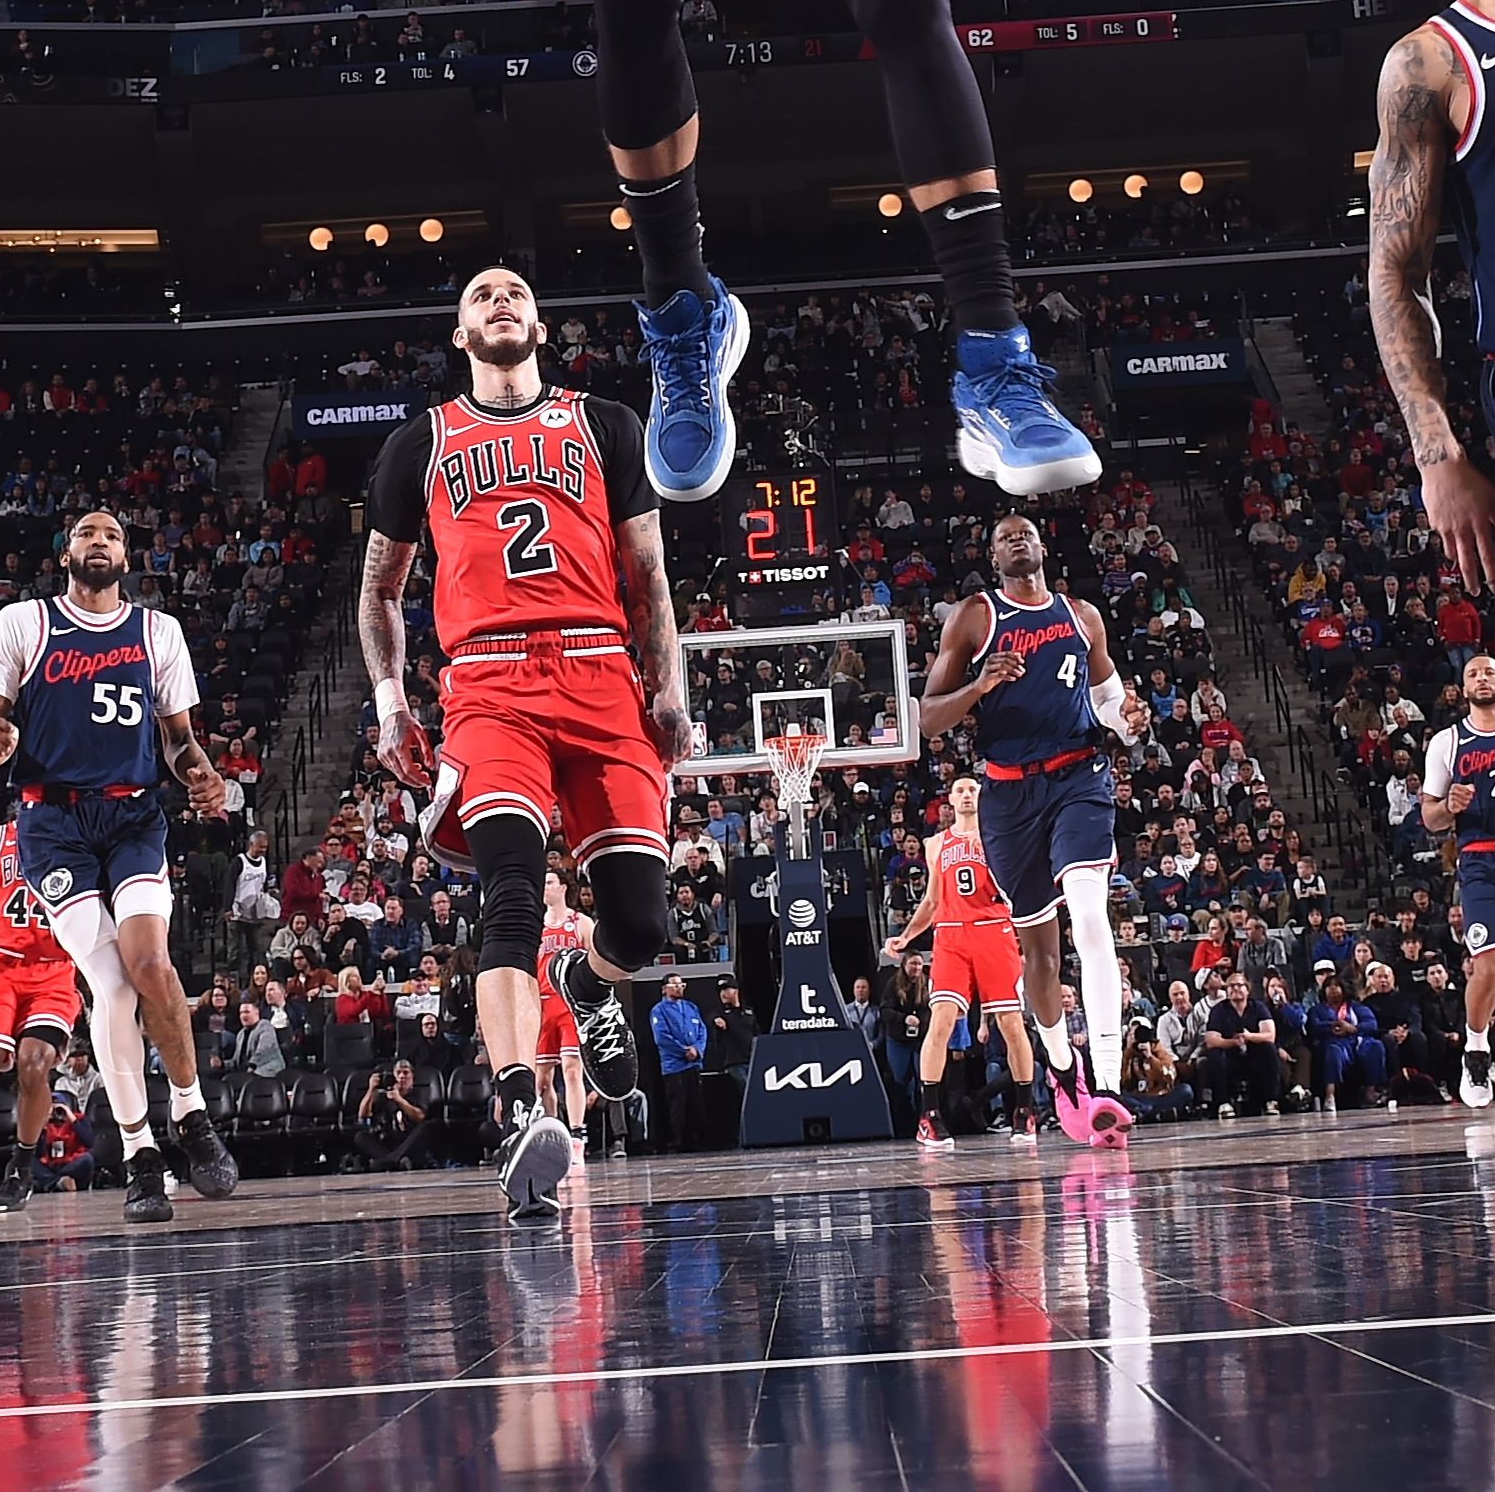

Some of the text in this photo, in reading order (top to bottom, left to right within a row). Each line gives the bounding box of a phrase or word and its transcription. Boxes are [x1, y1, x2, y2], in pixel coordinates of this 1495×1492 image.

[967, 29, 994, 47] 62
[1066, 23, 1078, 41] 5
[1136, 19, 1149, 36] 0
[725, 41, 773, 65] 7:13
[374, 67, 386, 85] 2
[443, 63, 455, 81] 4
[506, 58, 530, 77] 57
[440, 433, 586, 521] BULLS
[755, 478, 816, 508] 7:12
[496, 498, 558, 580] 2
[746, 508, 815, 560] 21
[762, 566, 829, 583] TISSOT
[998, 621, 1075, 657] Clippers
[44, 644, 145, 684] Clippers
[1057, 654, 1078, 688] 4
[91, 682, 143, 727] 55
[955, 866, 976, 896] 9
[785, 930, 822, 947] AT&T
